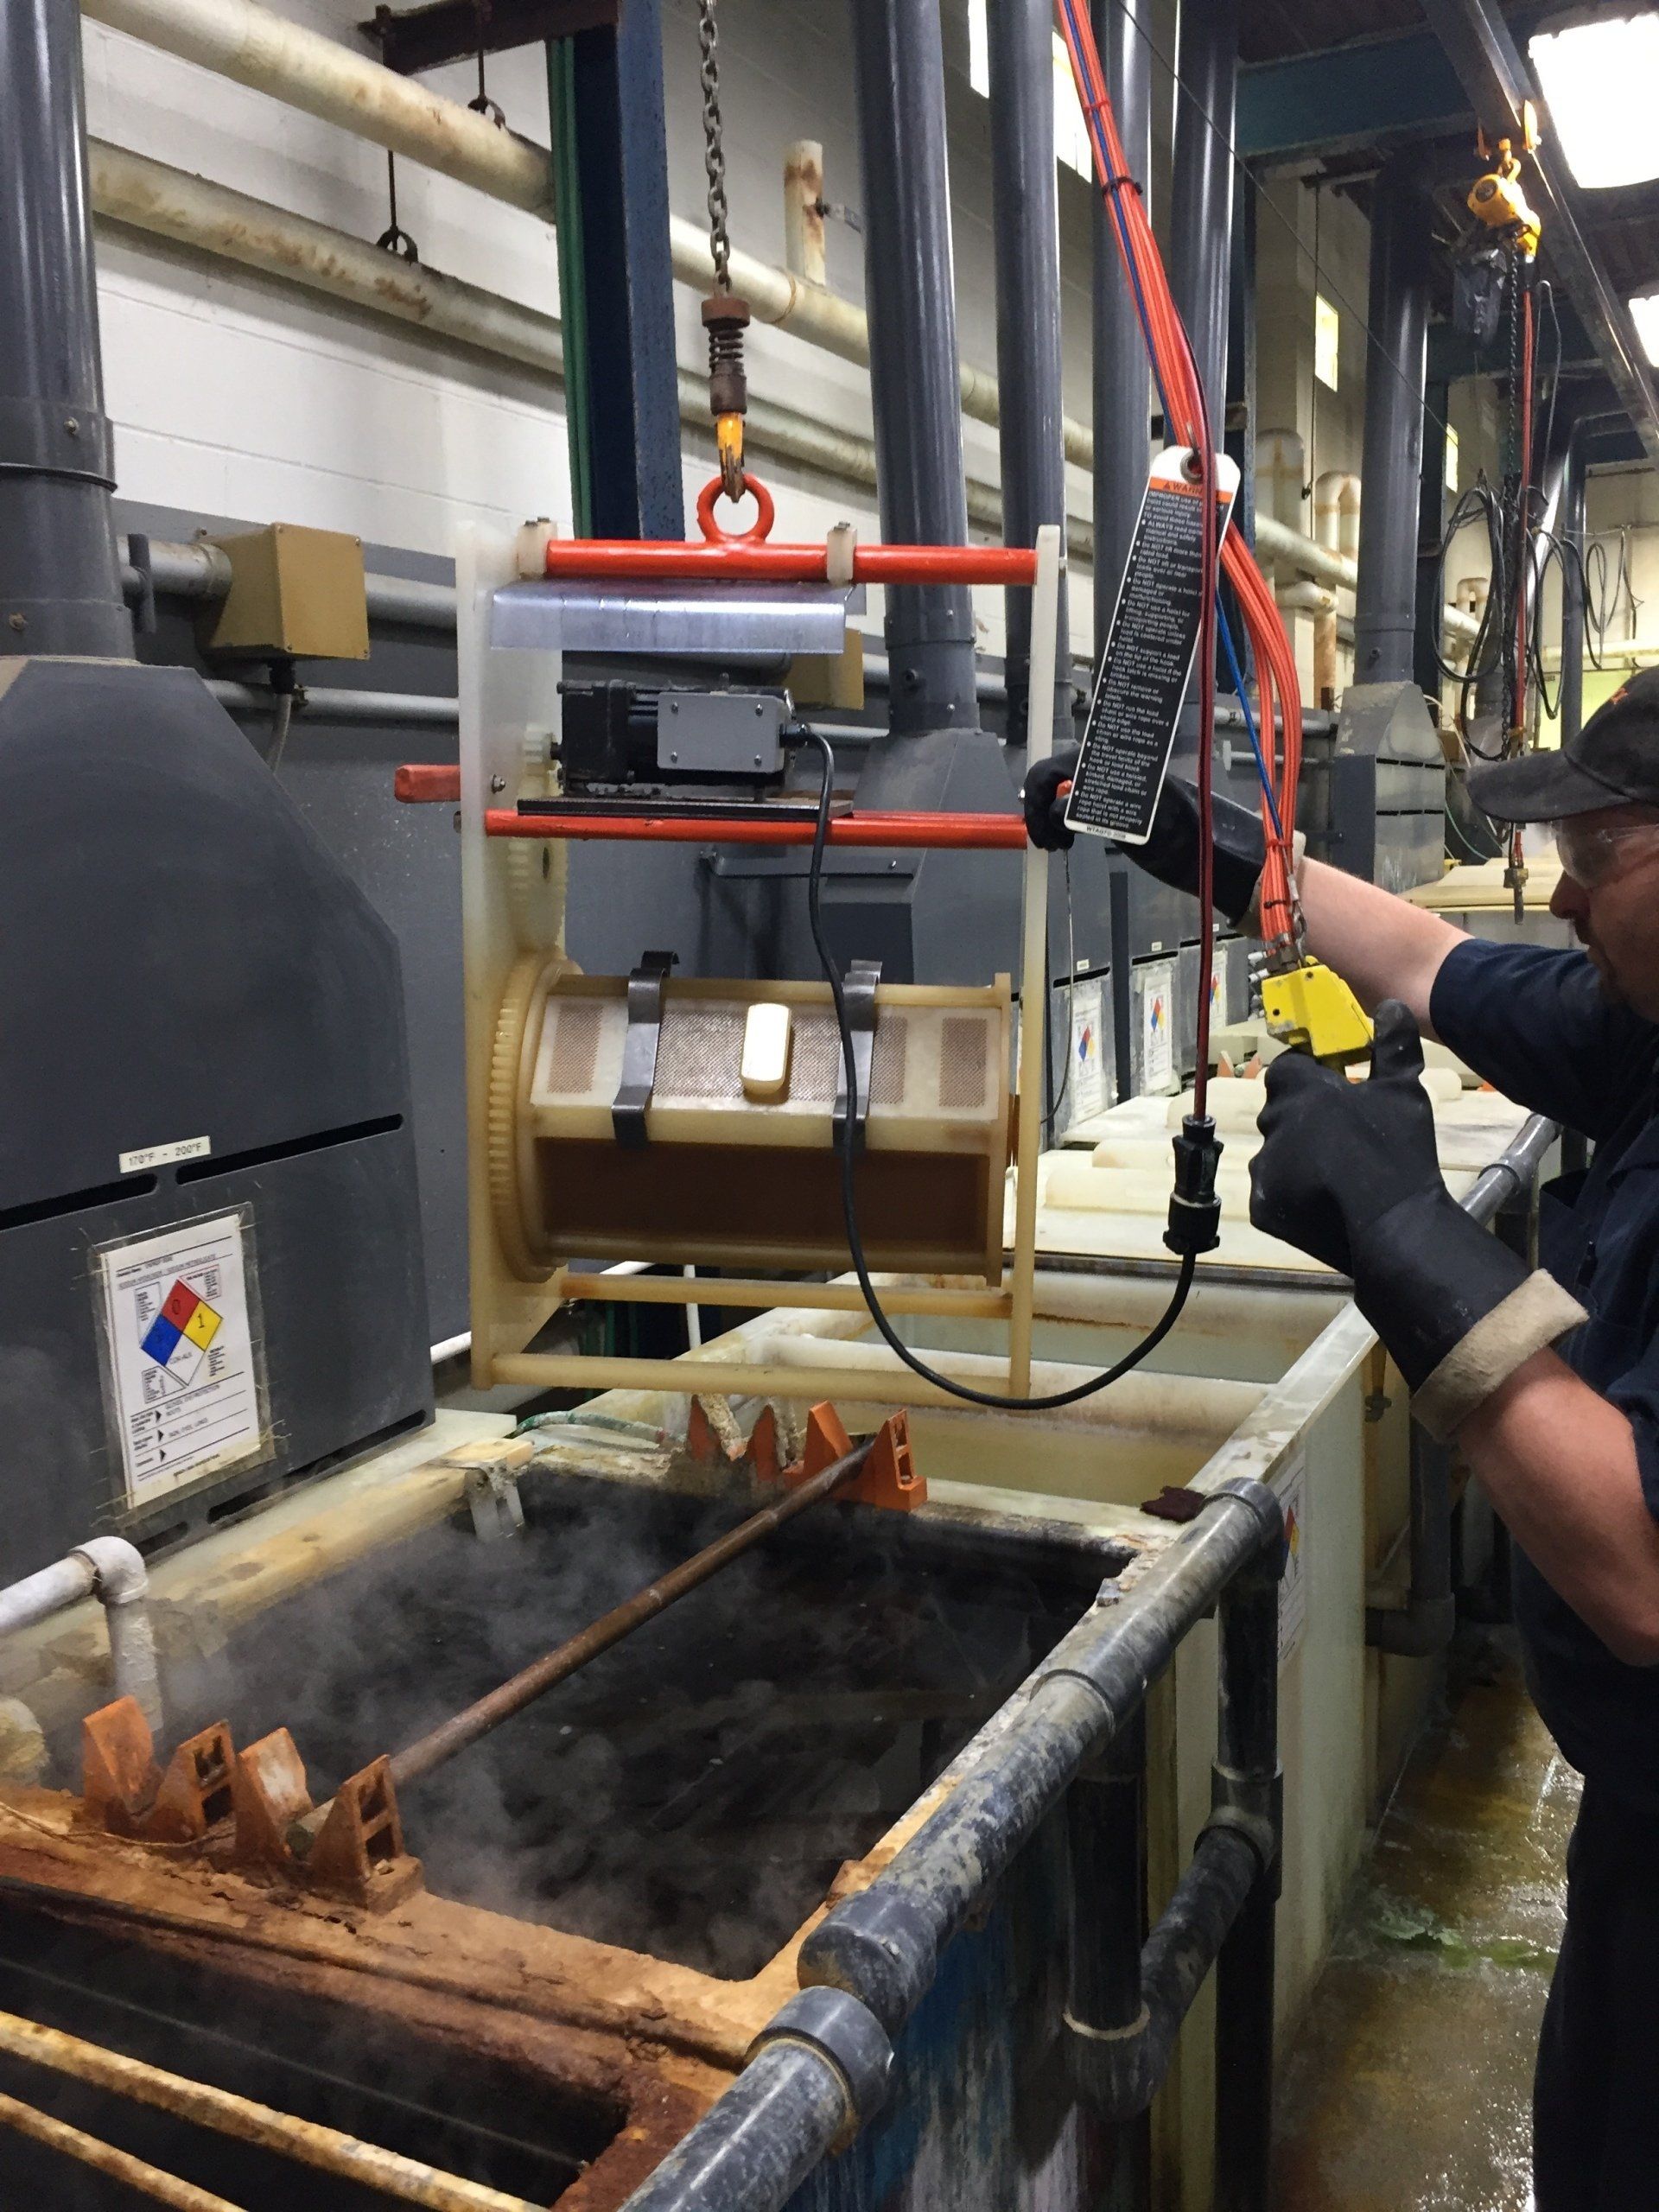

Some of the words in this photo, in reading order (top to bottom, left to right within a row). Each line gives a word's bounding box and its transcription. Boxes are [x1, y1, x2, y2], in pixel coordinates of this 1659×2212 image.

[1173, 481, 1203, 494] WARN
[175, 1142, 201, 1156] 200°F
[197, 1313, 205, 1328] 1
